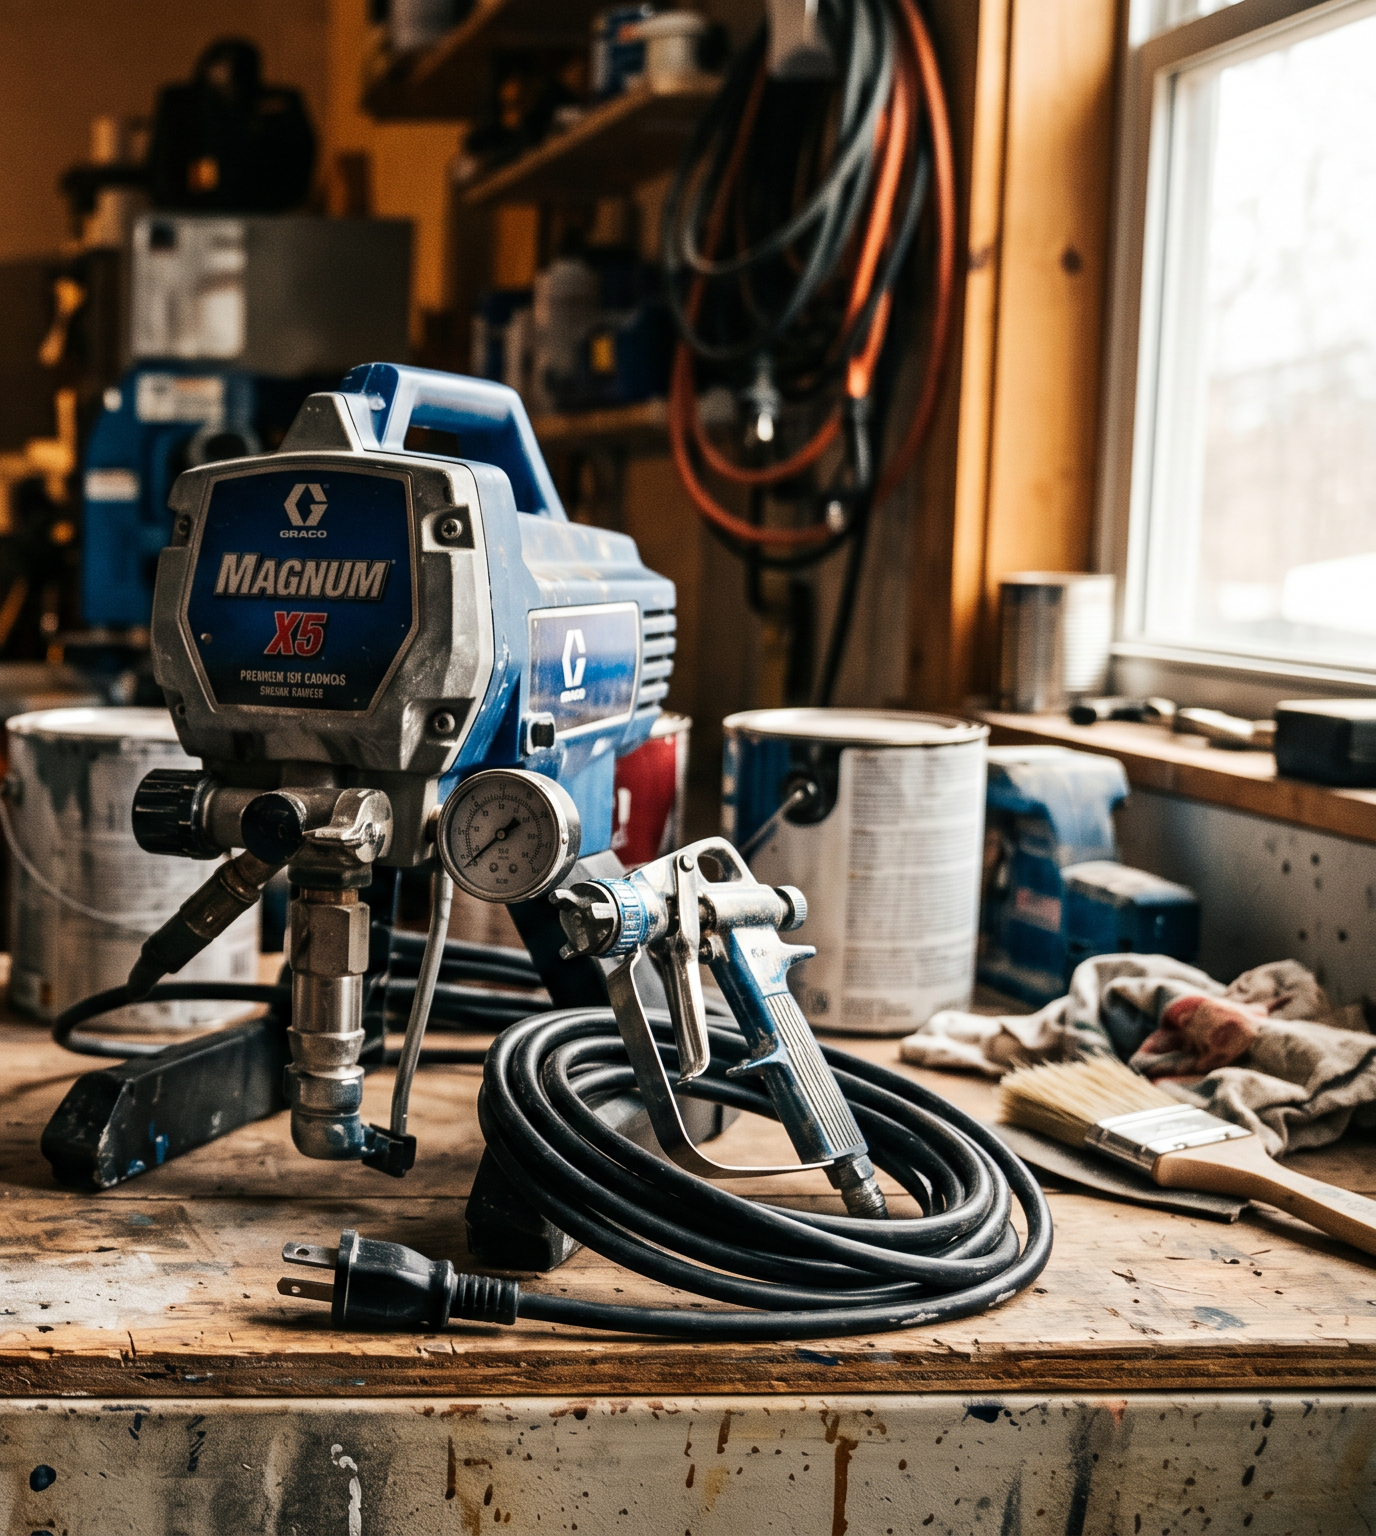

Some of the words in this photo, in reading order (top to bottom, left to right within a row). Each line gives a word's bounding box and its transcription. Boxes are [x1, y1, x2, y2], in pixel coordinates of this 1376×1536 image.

[279, 530, 327, 539] GRACO
[213, 552, 391, 600] MAGNUM
[264, 611, 328, 657] X5
